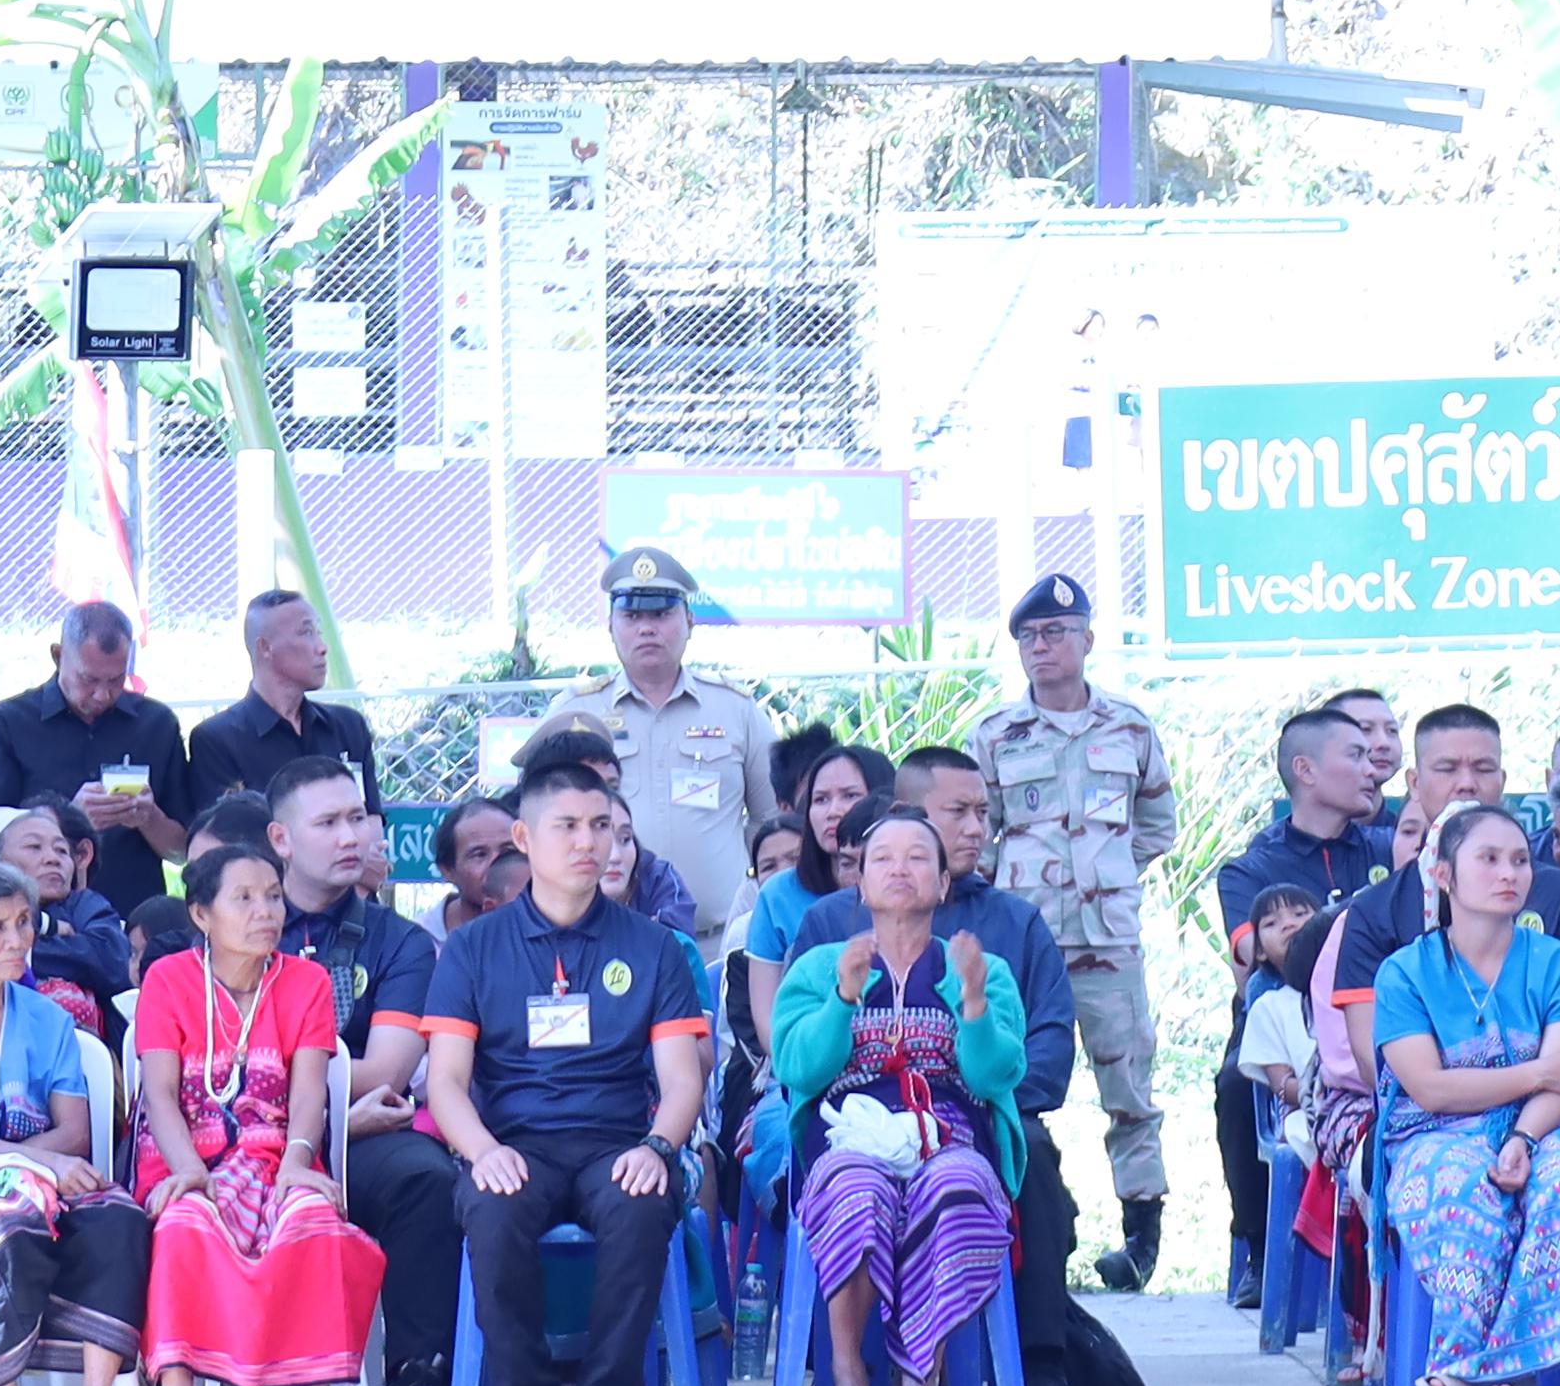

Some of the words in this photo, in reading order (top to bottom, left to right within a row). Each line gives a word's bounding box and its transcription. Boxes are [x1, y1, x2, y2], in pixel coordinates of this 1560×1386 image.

[90, 336, 121, 348] Solar
[124, 336, 153, 350] Light
[1183, 558, 1416, 617] Livestock
